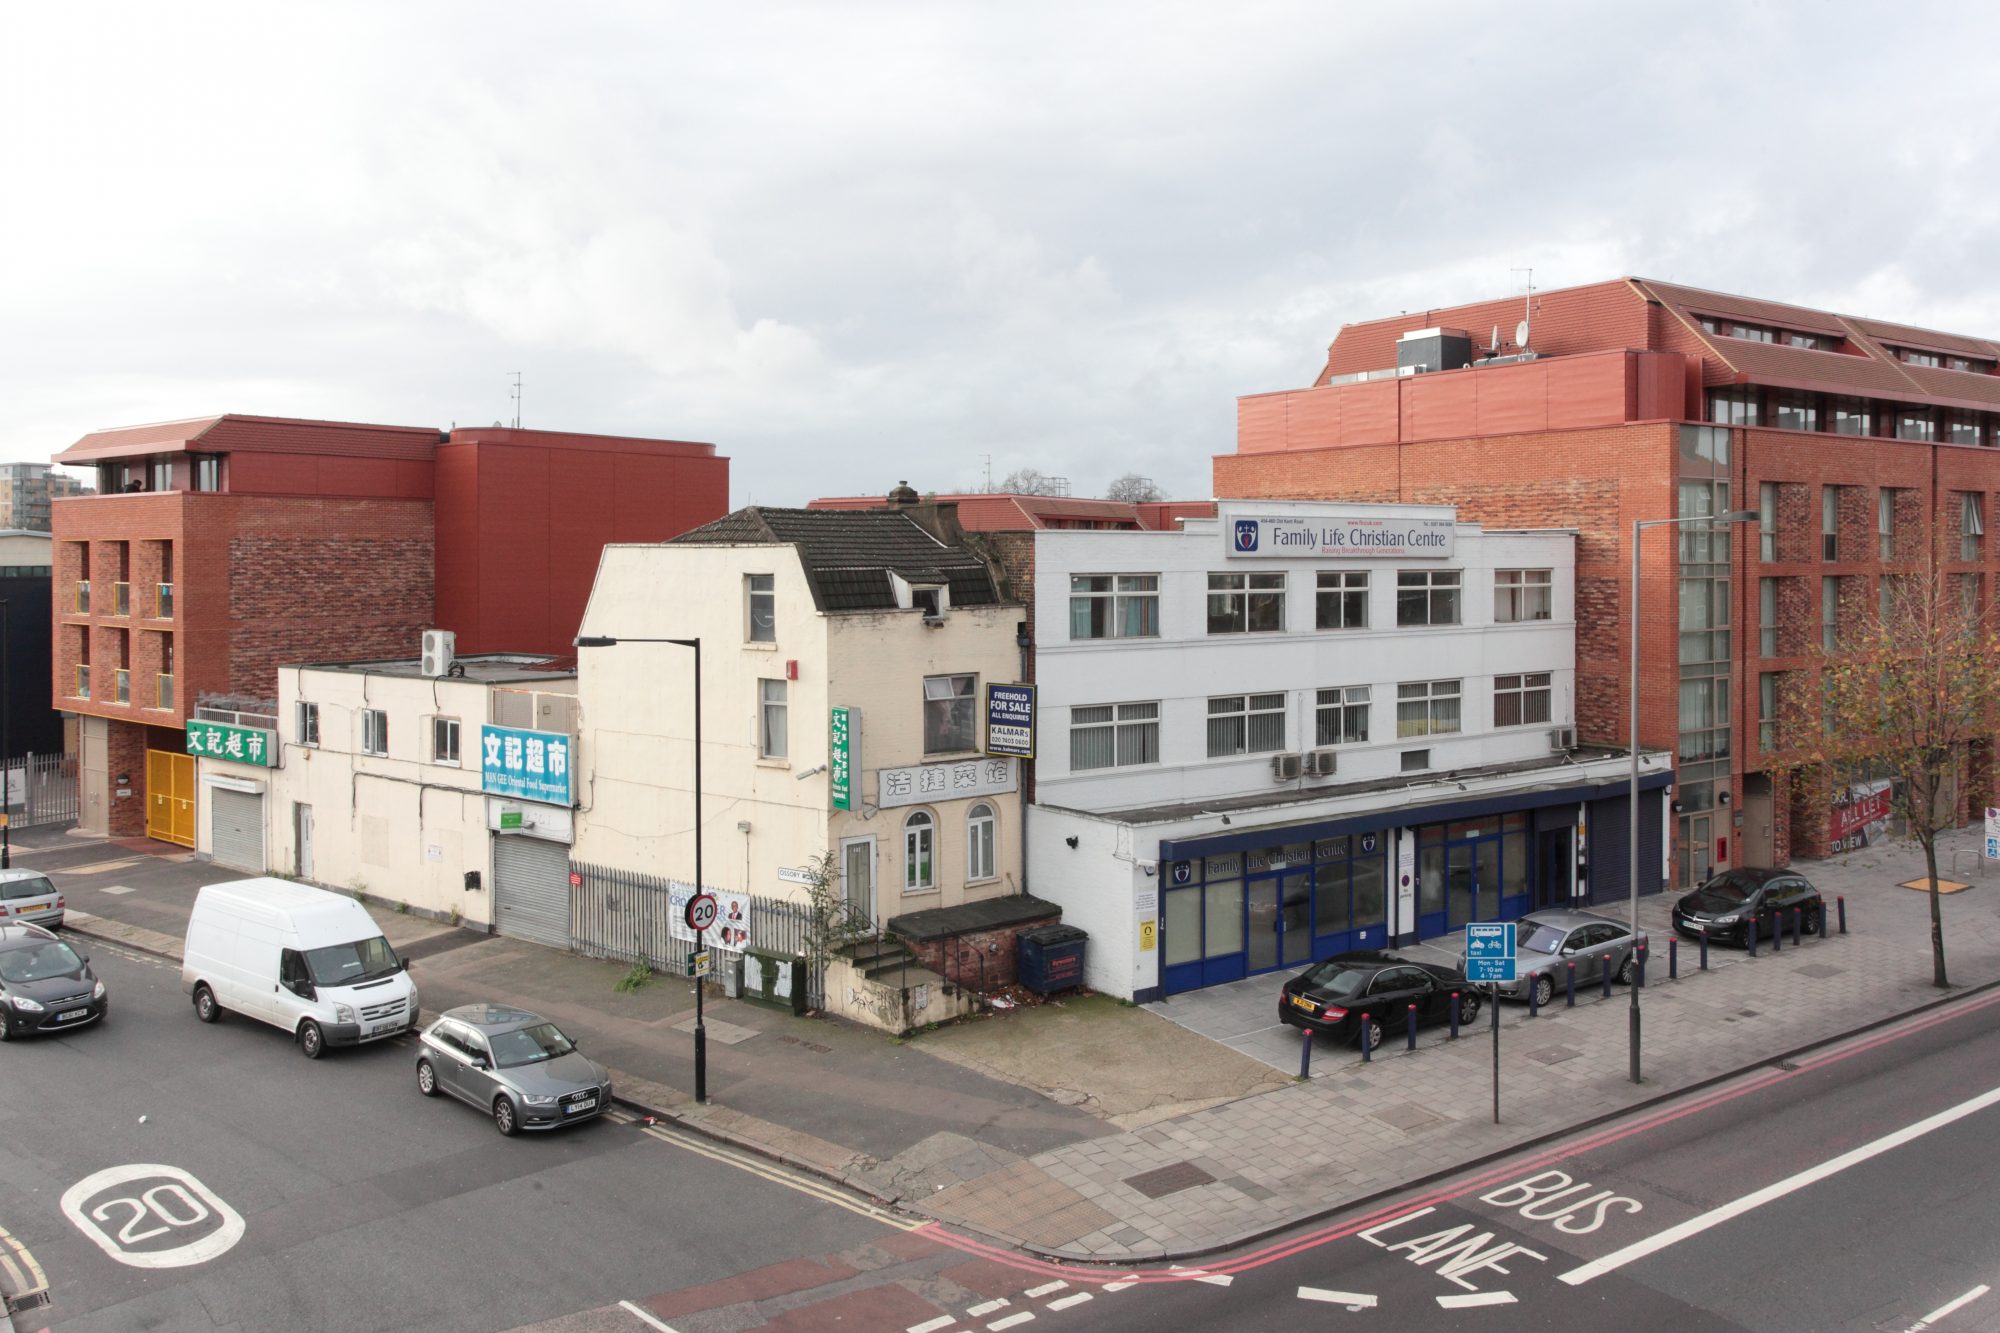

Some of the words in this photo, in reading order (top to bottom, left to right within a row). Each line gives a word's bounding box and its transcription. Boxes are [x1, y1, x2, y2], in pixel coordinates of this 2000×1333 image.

[1273, 528, 1317, 550] Family
[1322, 528, 1345, 546] Life
[1350, 528, 1405, 546] Christian
[1407, 529, 1446, 547] Centre
[1322, 546, 1340, 554] Raising
[1341, 547, 1375, 555] Breakthrough
[990, 700, 1007, 711] FOR
[1009, 702, 1031, 713] SALE
[994, 691, 1027, 701] FREEHOLD
[991, 711, 1001, 719] ALL
[1002, 713, 1029, 722] ENQUIRIES
[484, 732, 567, 777] 文記超市
[485, 772, 497, 783] MAN
[497, 773, 507, 785] GEE
[508, 775, 526, 788] Oriental
[526, 777, 538, 789] Food
[539, 779, 567, 794] Supermarket
[886, 761, 1008, 796] 洁捷菜馆
[1831, 840, 1841, 853] TO
[1842, 835, 1862, 849] VIEW
[1206, 858, 1240, 876] Family
[1248, 854, 1265, 869] Life
[1267, 849, 1311, 865] Christian
[1316, 843, 1347, 858] Centre
[780, 870, 800, 878] OSSORY
[695, 904, 714, 921] 20
[1479, 1170, 1642, 1234] BUS
[93, 1184, 208, 1244] 20
[1357, 1206, 1548, 1290] LANE
